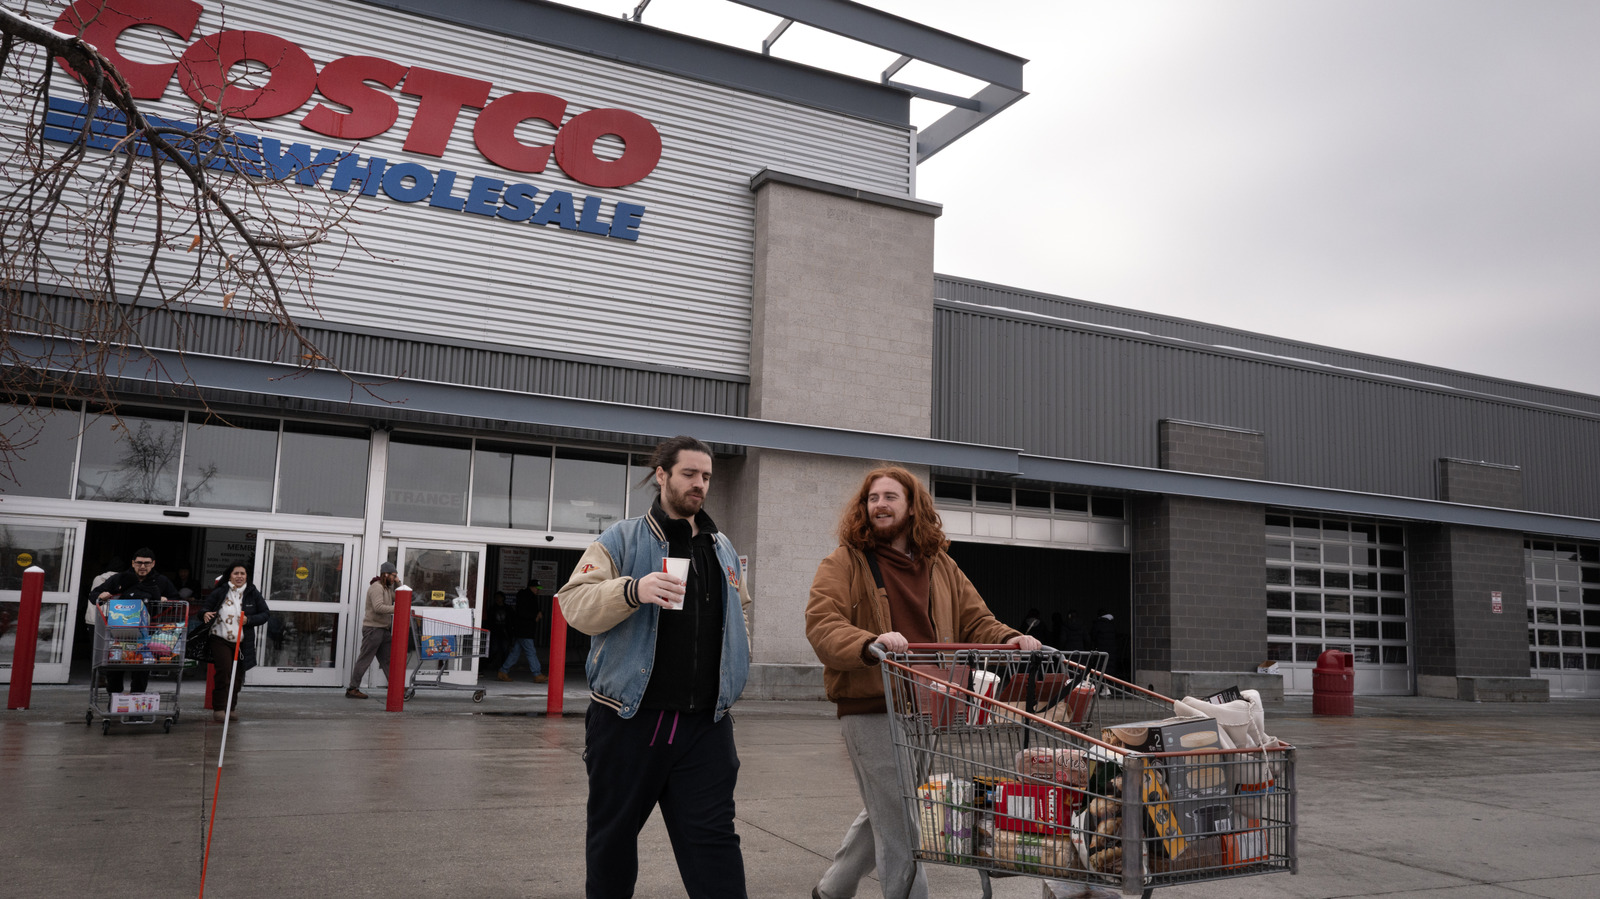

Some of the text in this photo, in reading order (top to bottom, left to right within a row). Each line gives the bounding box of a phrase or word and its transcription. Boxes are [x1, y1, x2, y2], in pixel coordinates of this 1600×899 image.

[53, 0, 662, 188] COSTCO
[259, 137, 645, 241] WHOLESALE
[1154, 733, 1162, 748] 2
